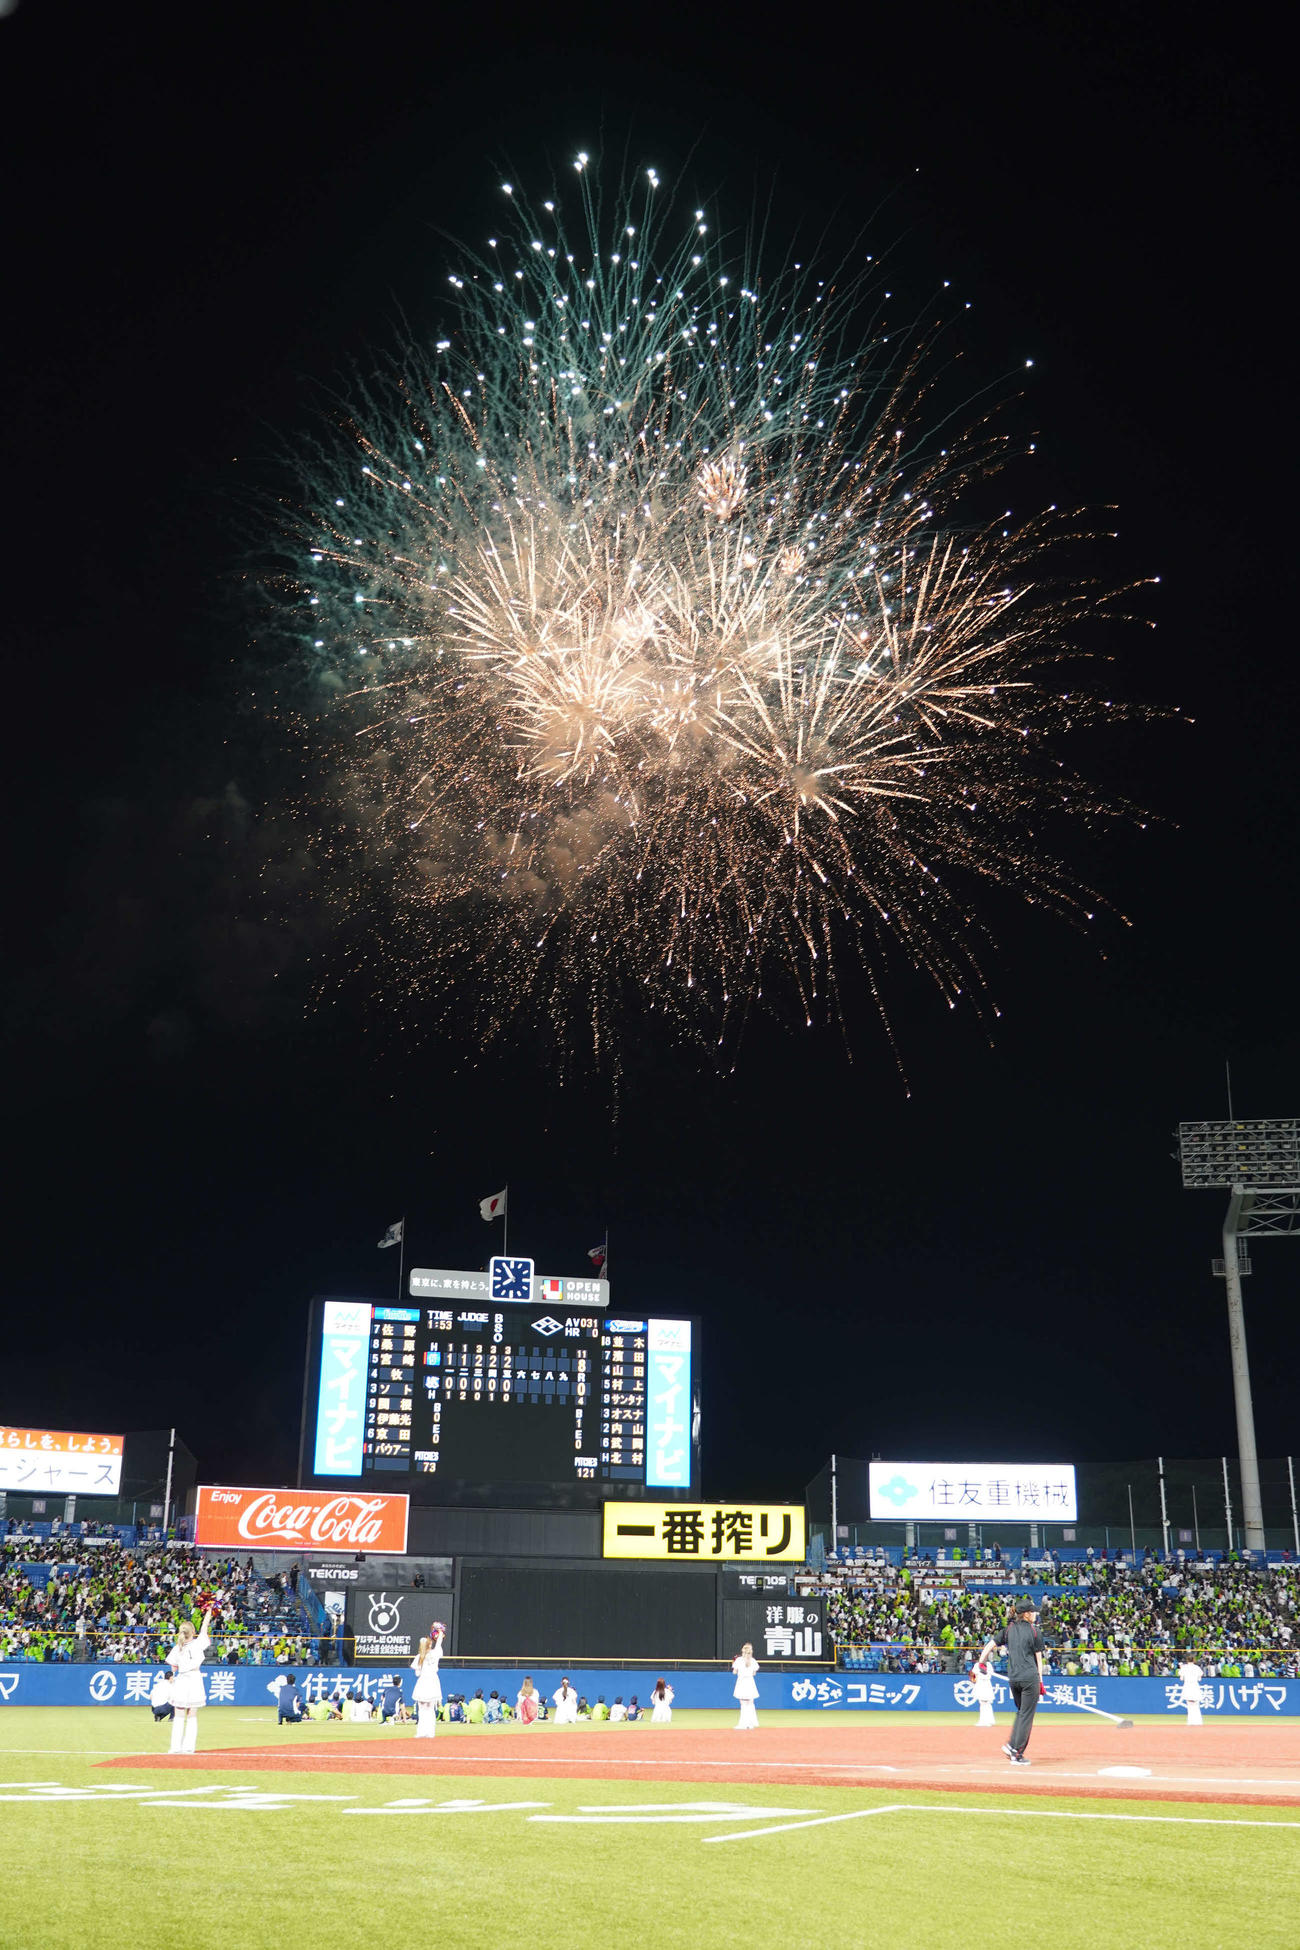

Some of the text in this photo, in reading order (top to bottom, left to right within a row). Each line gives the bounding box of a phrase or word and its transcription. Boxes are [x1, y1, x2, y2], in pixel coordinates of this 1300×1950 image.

[412, 1277, 489, 1290] 東京に、家を持とう。
[567, 1282, 600, 1292] OPEN
[567, 1292, 600, 1302] HOUSE
[427, 1310, 489, 1322] TIME JUDGE
[427, 1321, 452, 1330] 1:53
[565, 1318, 598, 1327] AV 031
[374, 1324, 380, 1334] 7
[565, 1328, 598, 1337] HR 0
[373, 1339, 380, 1348] 8
[430, 1342, 438, 1351] H
[476, 1345, 482, 1353] 3
[490, 1345, 497, 1353] 3
[505, 1346, 511, 1354] 3
[577, 1350, 586, 1358] 11
[372, 1354, 378, 1363] 5
[605, 1351, 610, 1360] 7
[475, 1356, 482, 1366] 2
[489, 1356, 497, 1366] 2
[504, 1356, 511, 1367] 2
[578, 1359, 586, 1372] 8
[371, 1369, 378, 1378] 4
[459, 1368, 469, 1376] 二
[474, 1369, 482, 1377] 三
[502, 1370, 512, 1378] 五
[517, 1370, 526, 1379] 六
[531, 1371, 540, 1380] 七
[545, 1371, 554, 1380] 八
[559, 1372, 568, 1381] 九
[578, 1373, 585, 1382] R
[604, 1365, 644, 1376] 4 山田
[370, 1384, 377, 1393] 3
[445, 1378, 453, 1388] 0
[460, 1378, 467, 1389] 0
[474, 1378, 481, 1390] 0
[489, 1379, 496, 1390] 0
[503, 1379, 510, 1391] 0
[577, 1382, 585, 1395] 0
[604, 1379, 644, 1391] 5 村上
[428, 1390, 435, 1399] H
[460, 1392, 466, 1400] 2
[474, 1392, 480, 1401] 0
[503, 1393, 509, 1402] 0
[578, 1396, 584, 1405] 4
[604, 1393, 644, 1406] 9 サンタナ
[325, 1338, 362, 1469] マイナビ
[369, 1399, 376, 1408] 9
[434, 1403, 441, 1412] B
[368, 1414, 375, 1423] 2
[434, 1413, 440, 1422] 0
[576, 1409, 582, 1418] B
[603, 1408, 644, 1420] 3 オスナ
[653, 1354, 685, 1480] マイナビ
[368, 1429, 374, 1437] 6
[433, 1424, 440, 1433] E
[603, 1423, 643, 1435] 2 内山
[433, 1434, 439, 1443] 0
[575, 1430, 582, 1439] E
[0, 1431, 120, 1454] らしを、しよう。
[575, 1440, 581, 1449] 0
[603, 1438, 609, 1447] 6
[368, 1444, 372, 1452] 1
[602, 1452, 643, 1465] H 北村
[423, 1462, 436, 1472] 73
[577, 1468, 594, 1478] 121
[211, 1490, 242, 1504] Enjoy
[929, 1479, 1069, 1507] 住友重機械
[617, 1510, 791, 1555] 一番搾り
[308, 1568, 358, 1580] TEKNOS
[739, 1576, 786, 1585] TENOS
[766, 1606, 818, 1624] 洋服の
[764, 1626, 822, 1656] 青山
